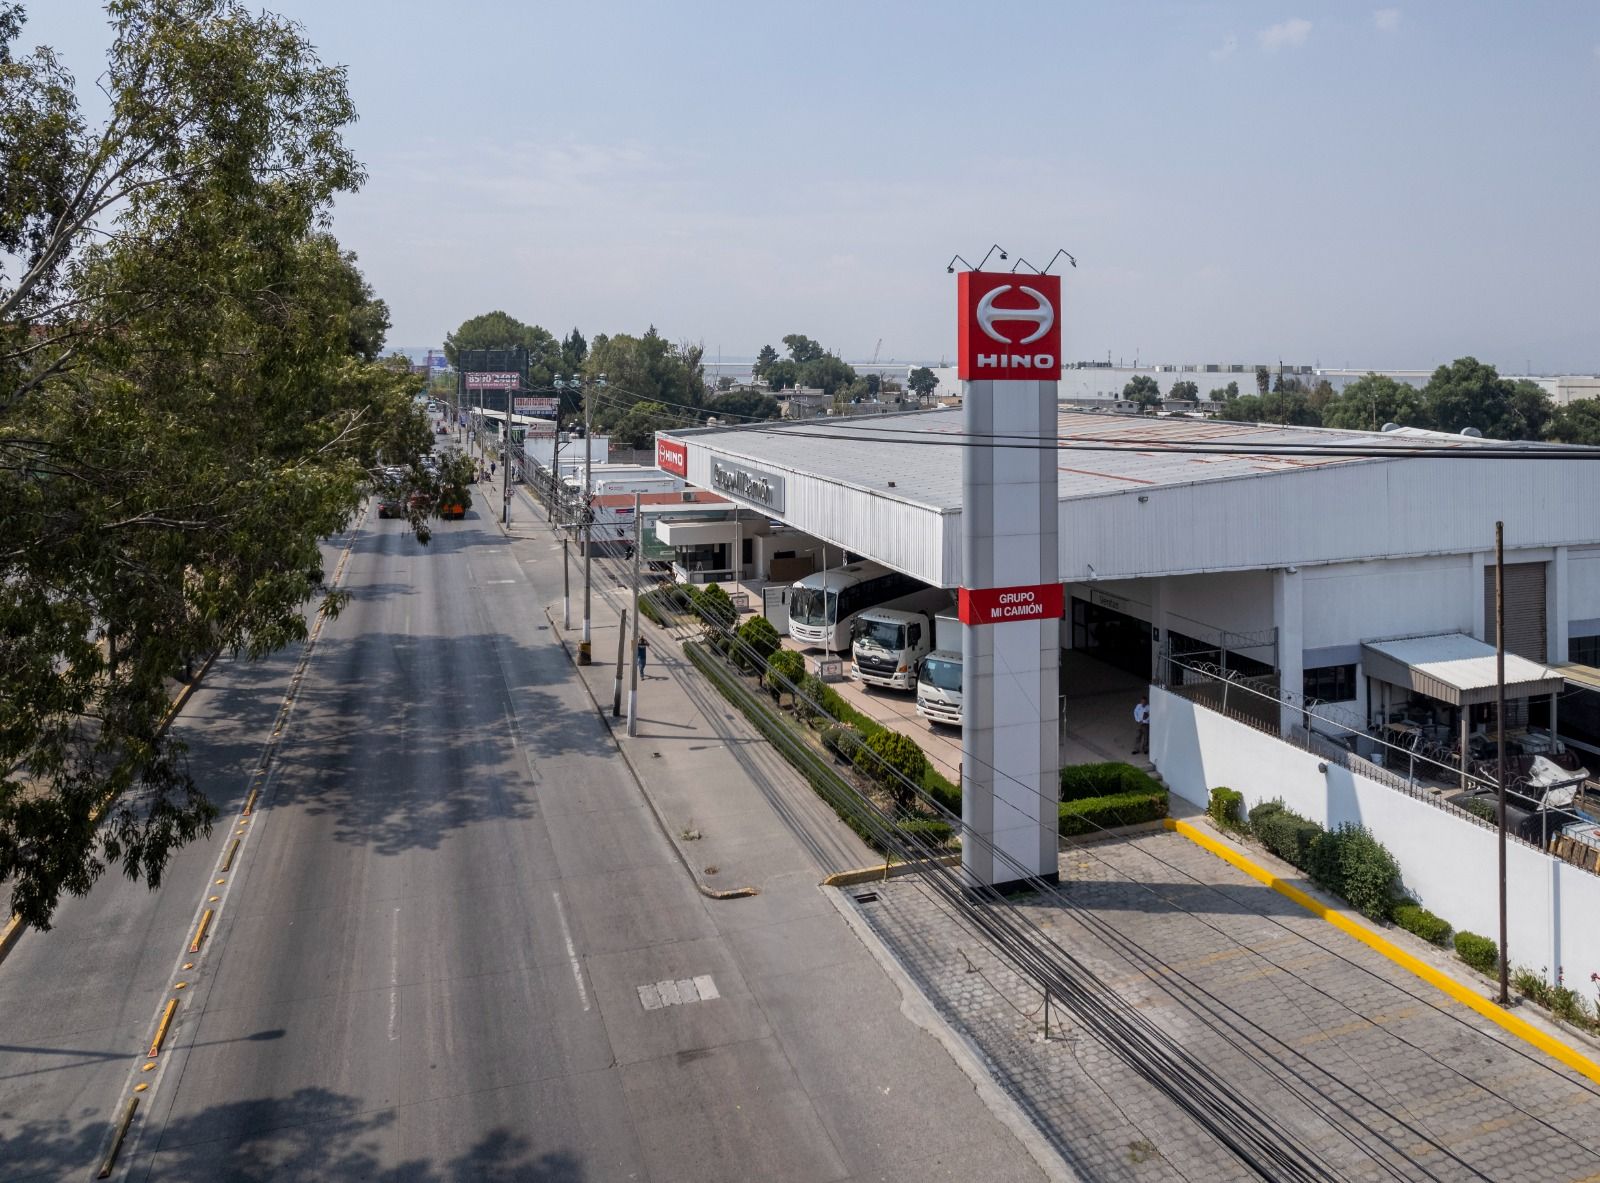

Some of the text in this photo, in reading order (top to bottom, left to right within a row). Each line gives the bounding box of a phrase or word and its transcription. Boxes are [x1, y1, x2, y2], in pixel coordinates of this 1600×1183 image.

[977, 353, 1054, 369] HINO
[665, 449, 683, 467] HINO
[999, 592, 1035, 604] GRUPO
[991, 602, 1043, 618] MI CAMIÓN
